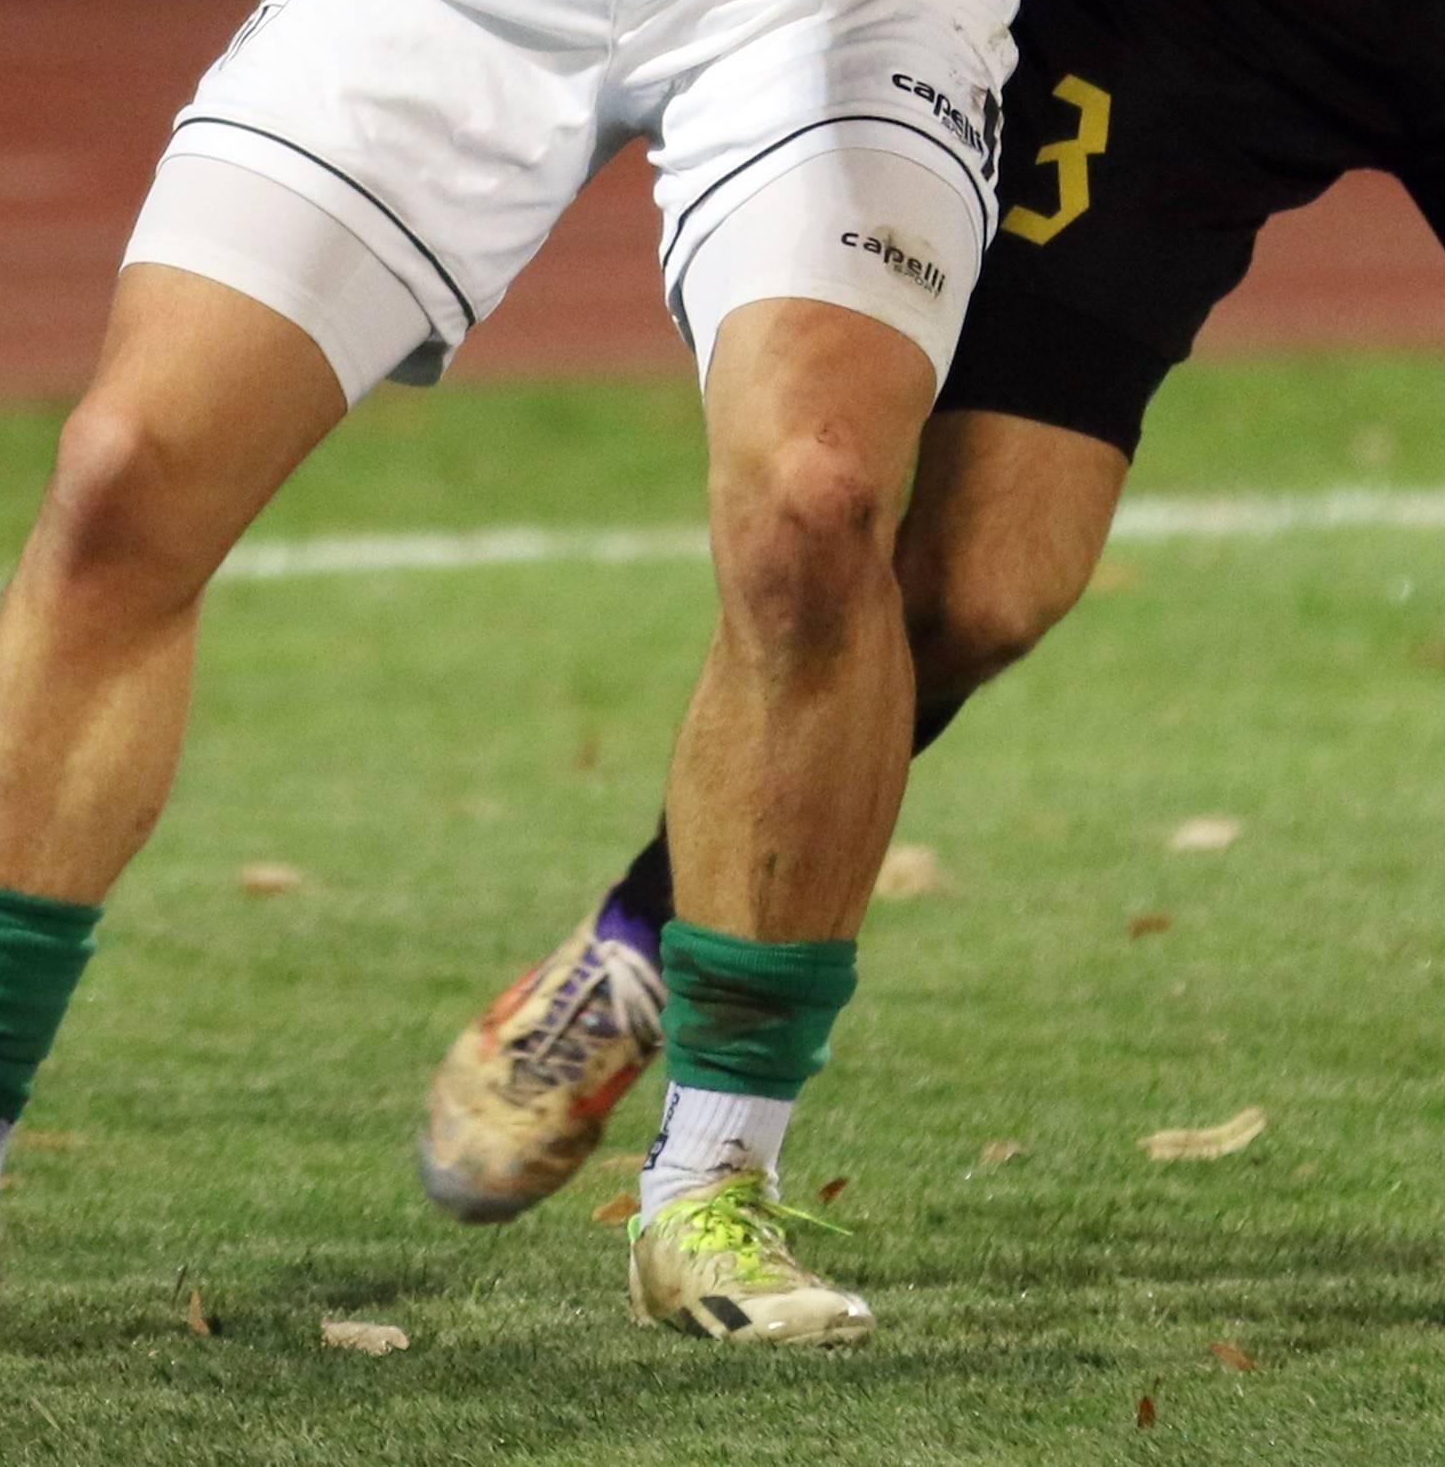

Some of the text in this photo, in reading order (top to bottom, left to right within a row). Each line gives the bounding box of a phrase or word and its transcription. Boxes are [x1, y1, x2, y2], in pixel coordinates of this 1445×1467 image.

[891, 73, 984, 156] capelli
[1000, 73, 1112, 246] 3
[840, 231, 946, 294] capelli
